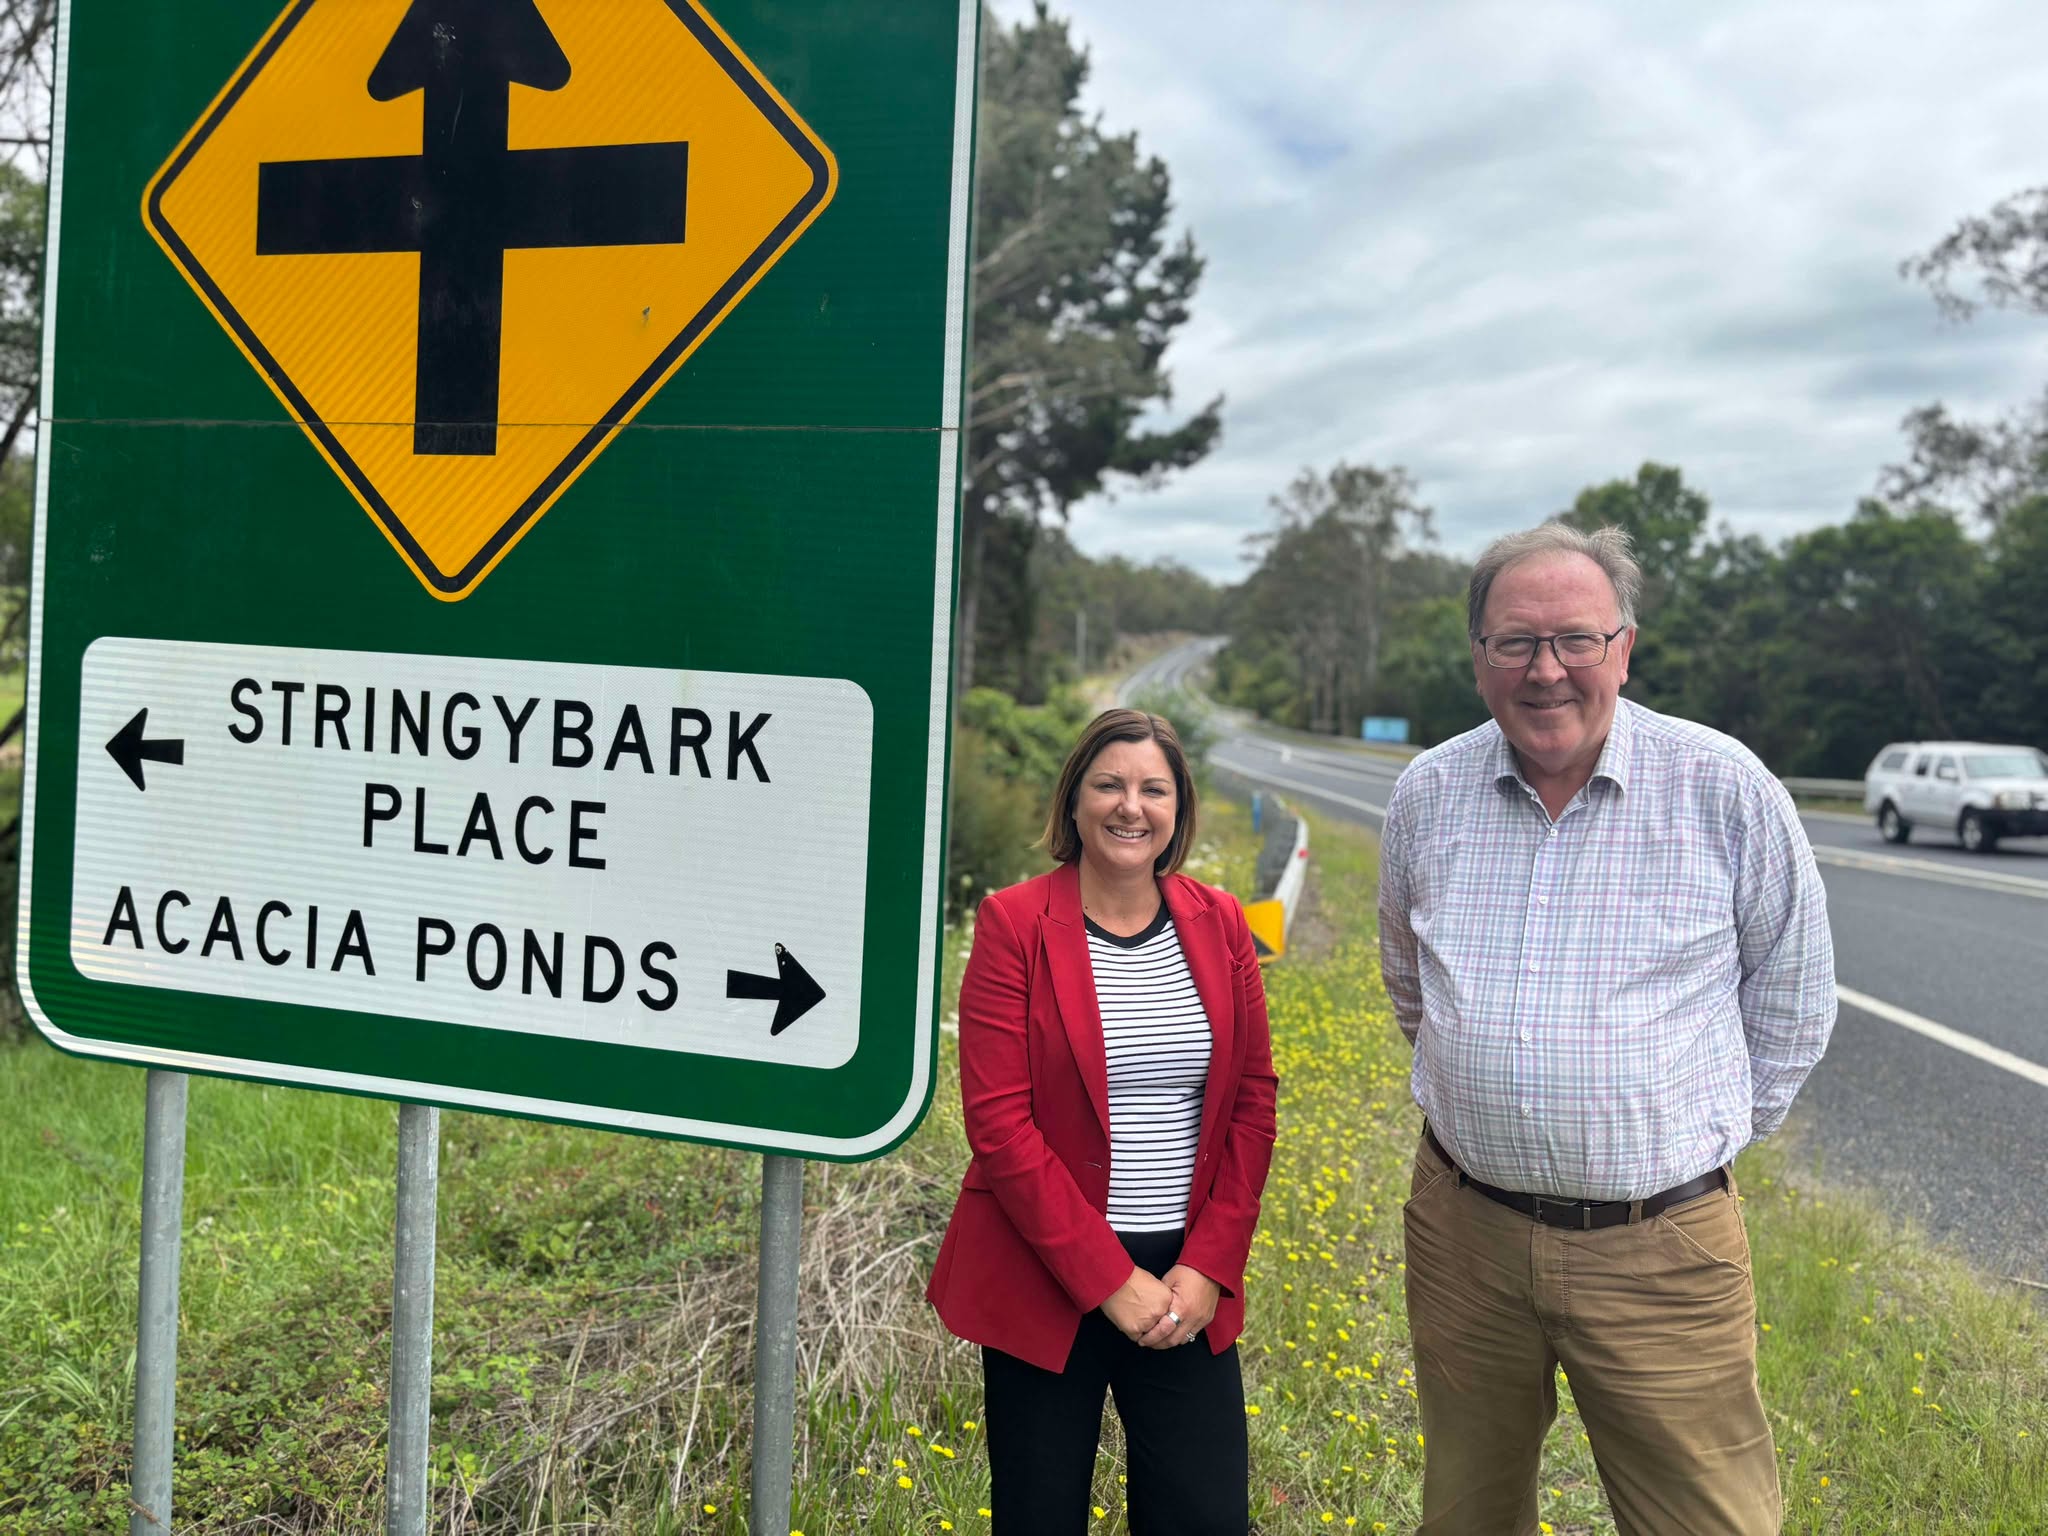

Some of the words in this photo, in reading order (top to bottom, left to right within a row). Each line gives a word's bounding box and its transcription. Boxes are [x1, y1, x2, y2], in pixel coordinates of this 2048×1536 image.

[228, 677, 772, 784] STRINGYBARK
[363, 783, 607, 870] PLACE
[102, 885, 376, 977] ACACIA
[415, 917, 679, 1012] PONDS
